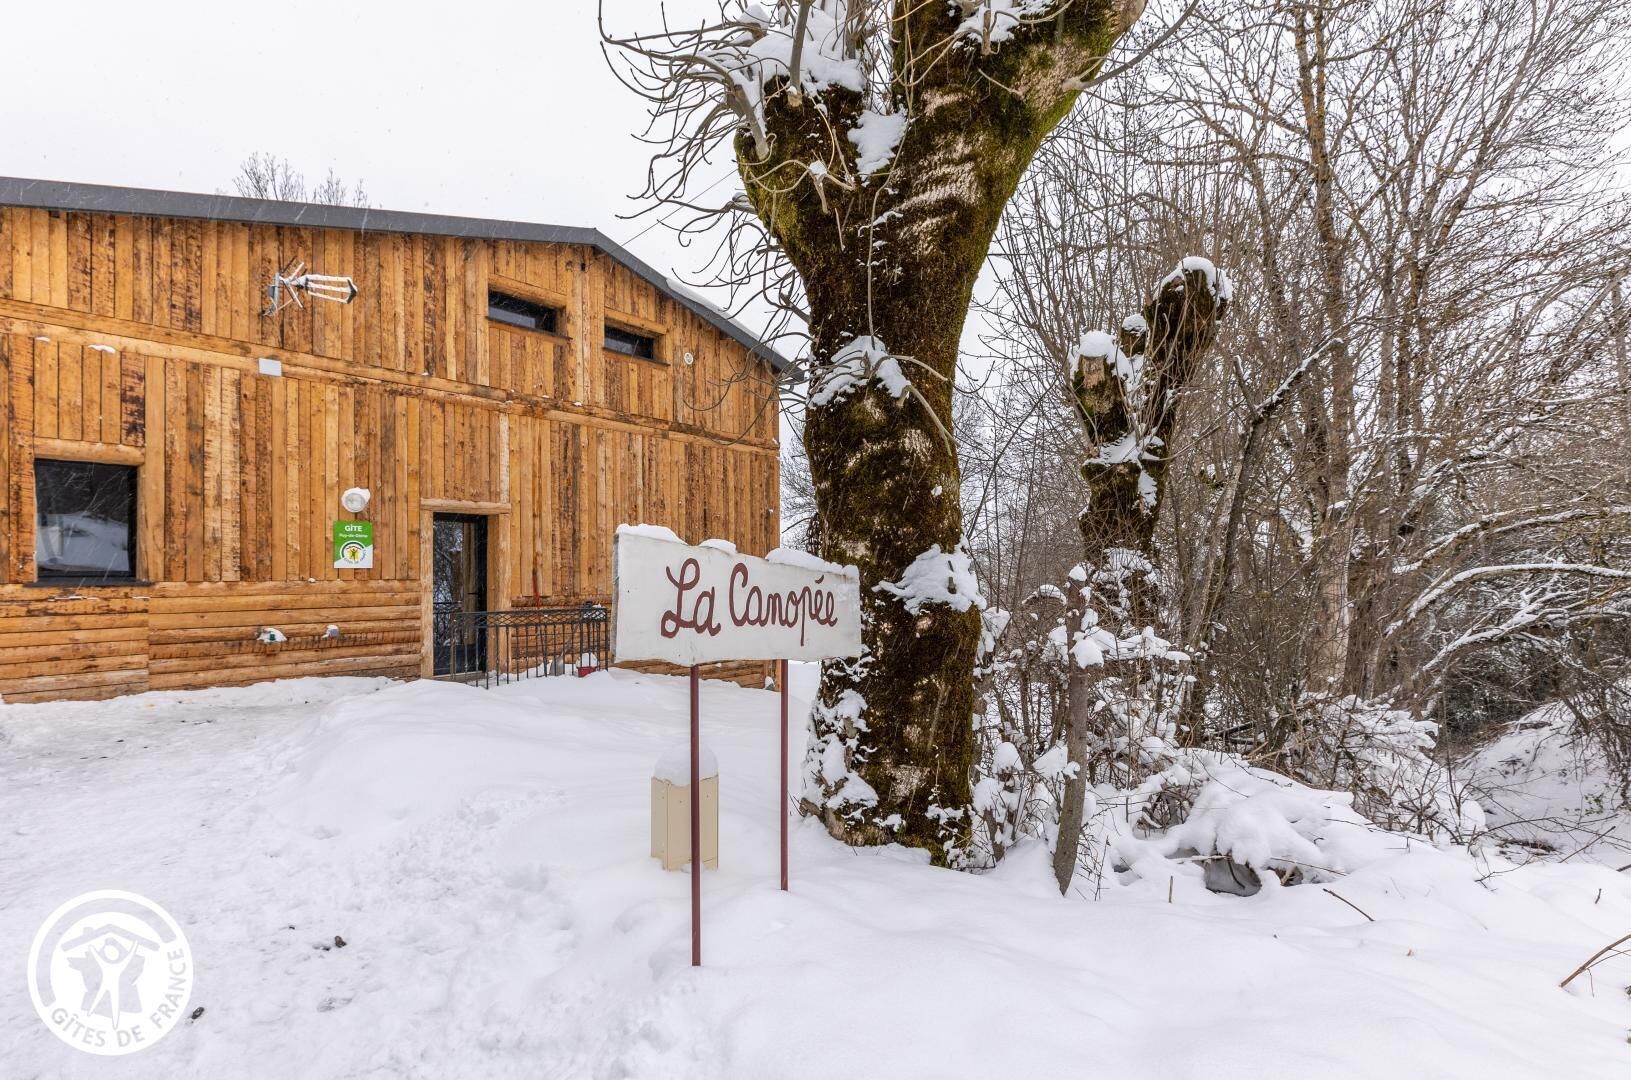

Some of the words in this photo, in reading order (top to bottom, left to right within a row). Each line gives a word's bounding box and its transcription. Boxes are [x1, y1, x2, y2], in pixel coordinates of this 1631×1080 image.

[344, 523, 363, 532] GÎTE
[660, 558, 721, 639] La
[728, 562, 838, 647] Canopée
